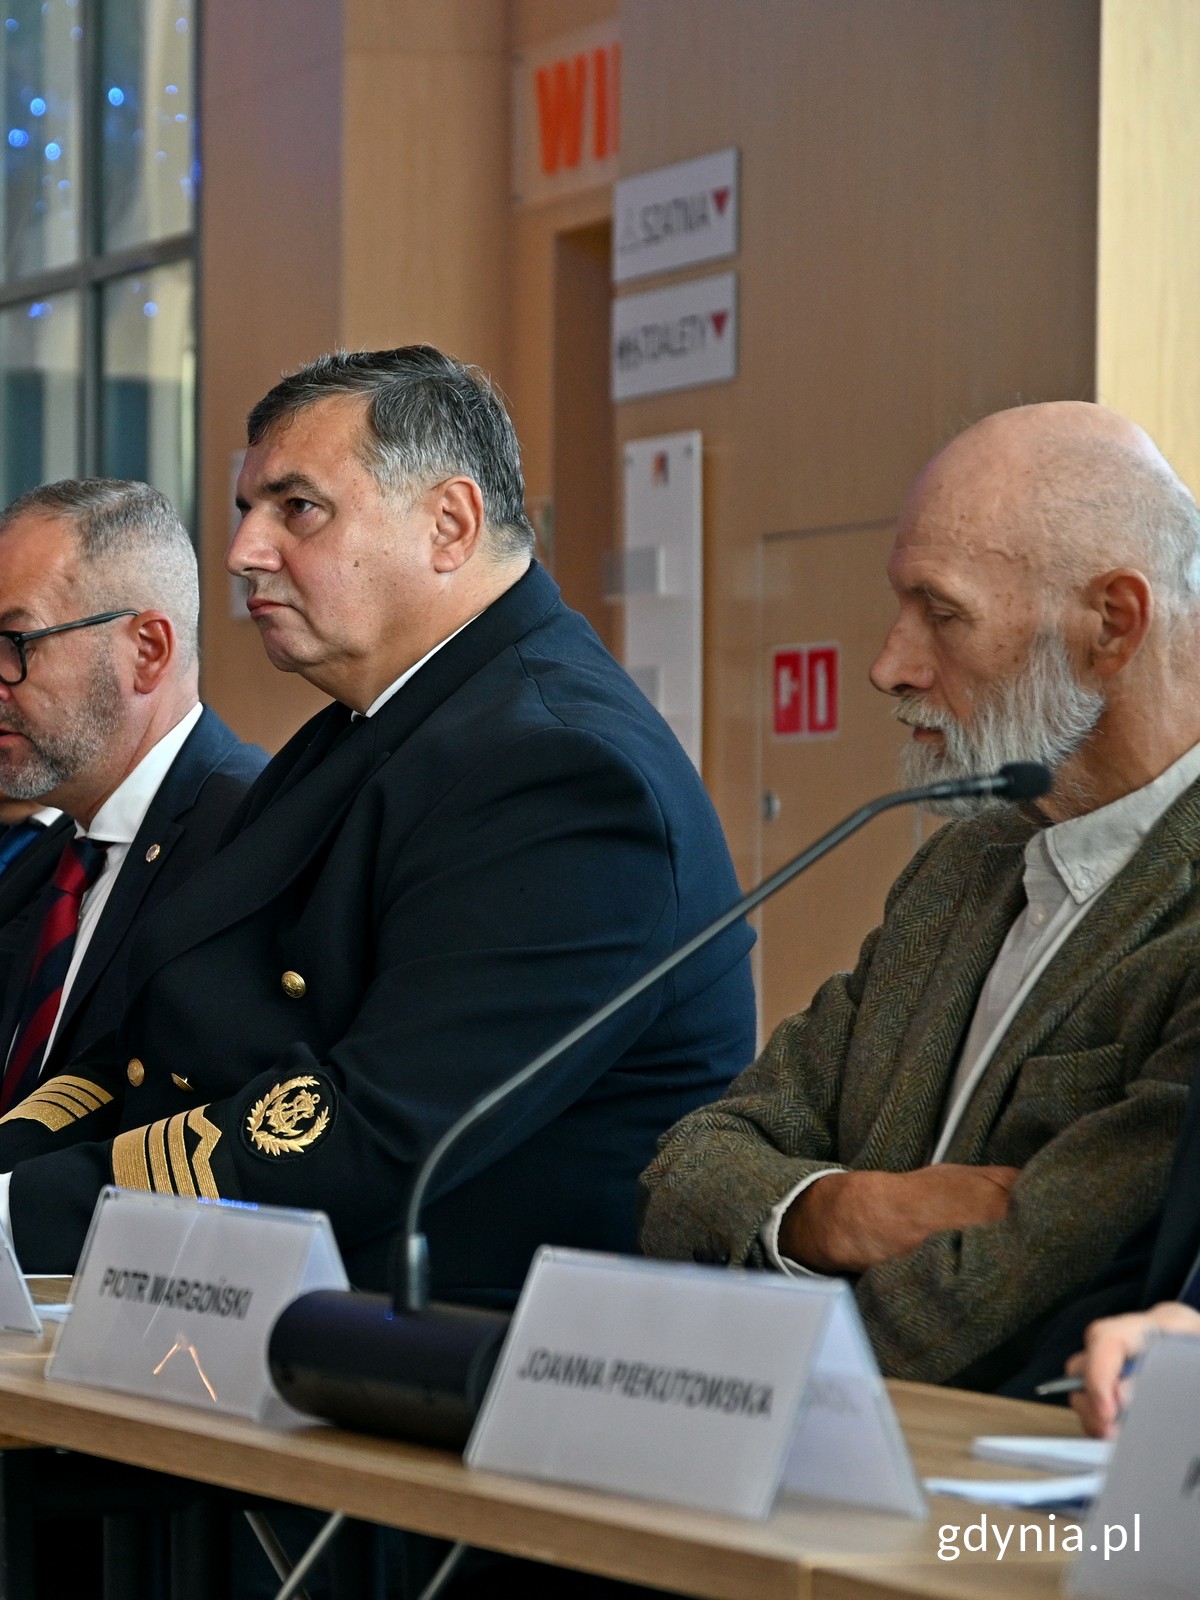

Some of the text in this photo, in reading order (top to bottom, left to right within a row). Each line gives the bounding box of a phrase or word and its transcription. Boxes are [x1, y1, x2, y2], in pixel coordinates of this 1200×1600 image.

[535, 43, 622, 174] WI
[100, 1267, 149, 1303] PIOTR
[518, 1349, 605, 1391] JOANNA
[608, 1358, 774, 1420] PIEKUTOWSKA
